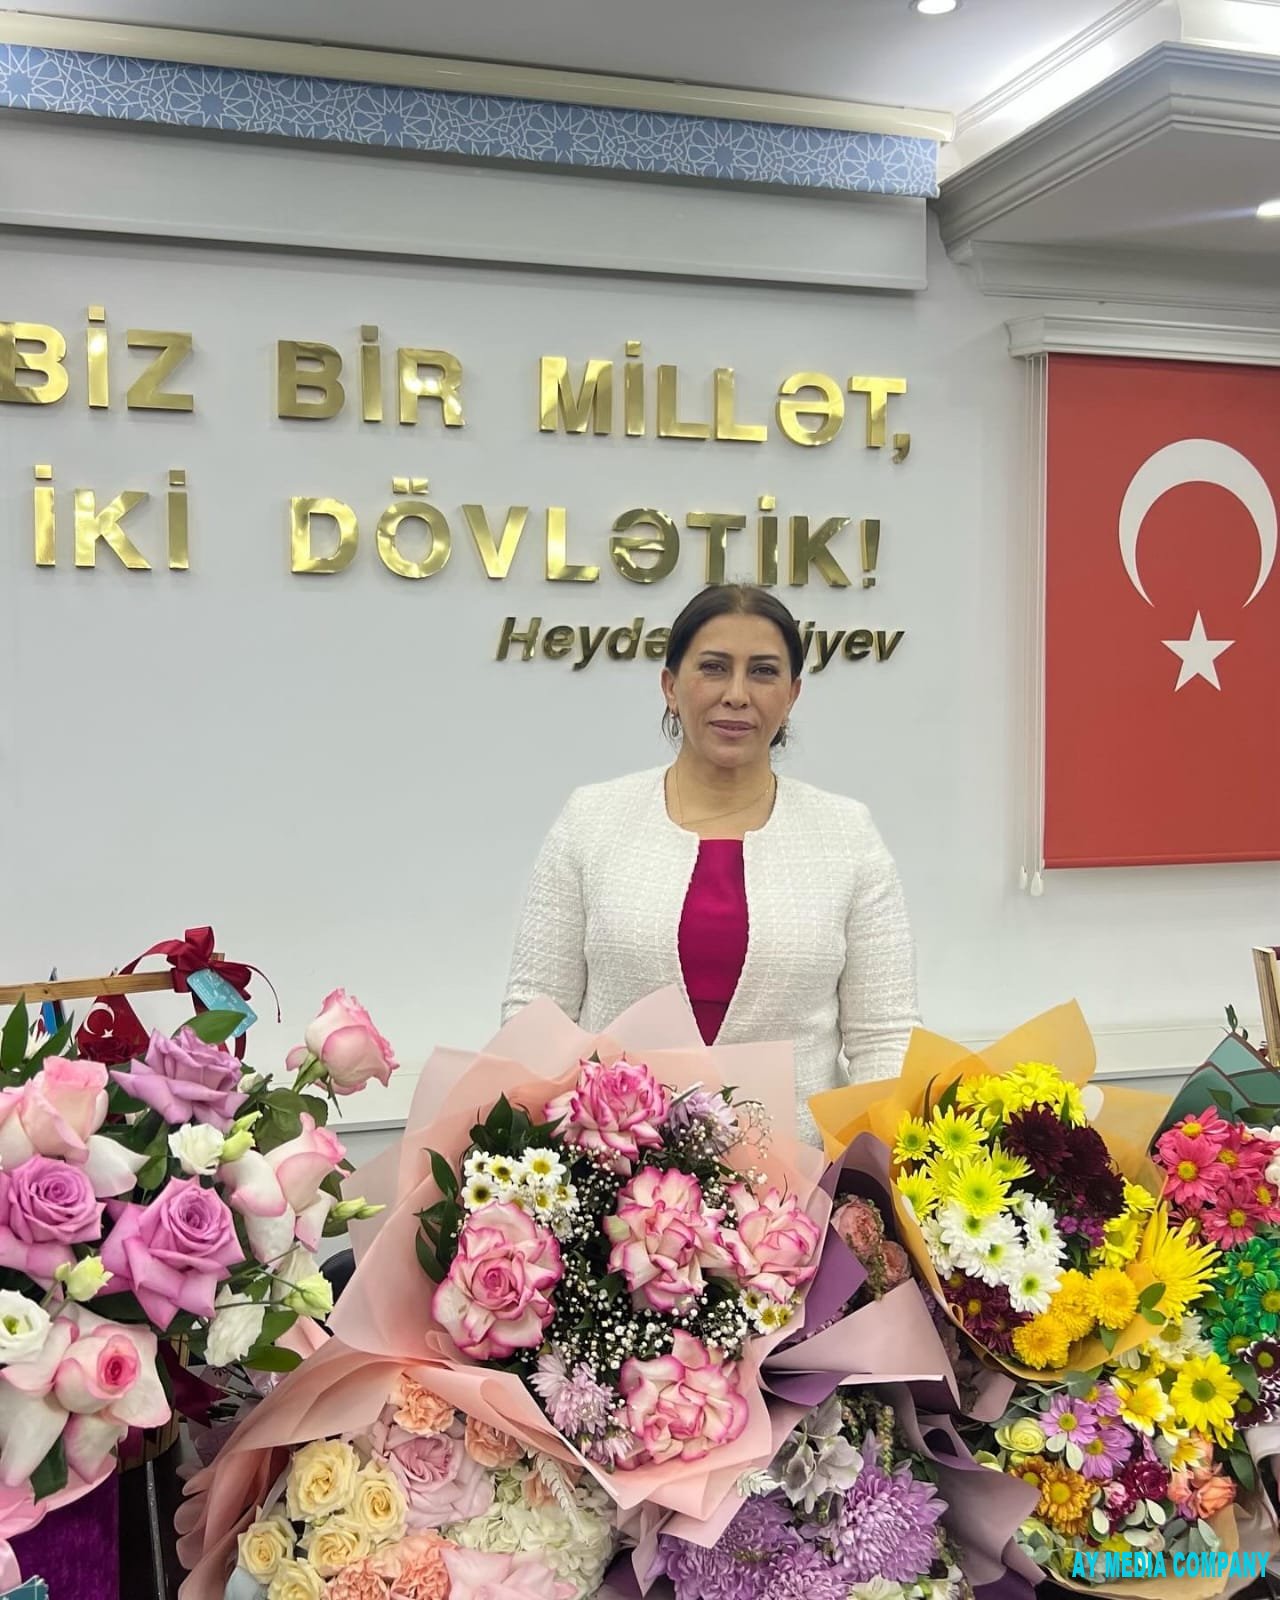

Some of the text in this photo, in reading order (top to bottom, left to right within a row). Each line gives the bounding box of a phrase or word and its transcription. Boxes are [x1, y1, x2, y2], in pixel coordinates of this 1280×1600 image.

[0, 304, 911, 465] BİZ BİR MİLLƏT,
[34, 464, 881, 589] İKİ DÖVLƏTİK!
[496, 616, 905, 673] Heydə iyev
